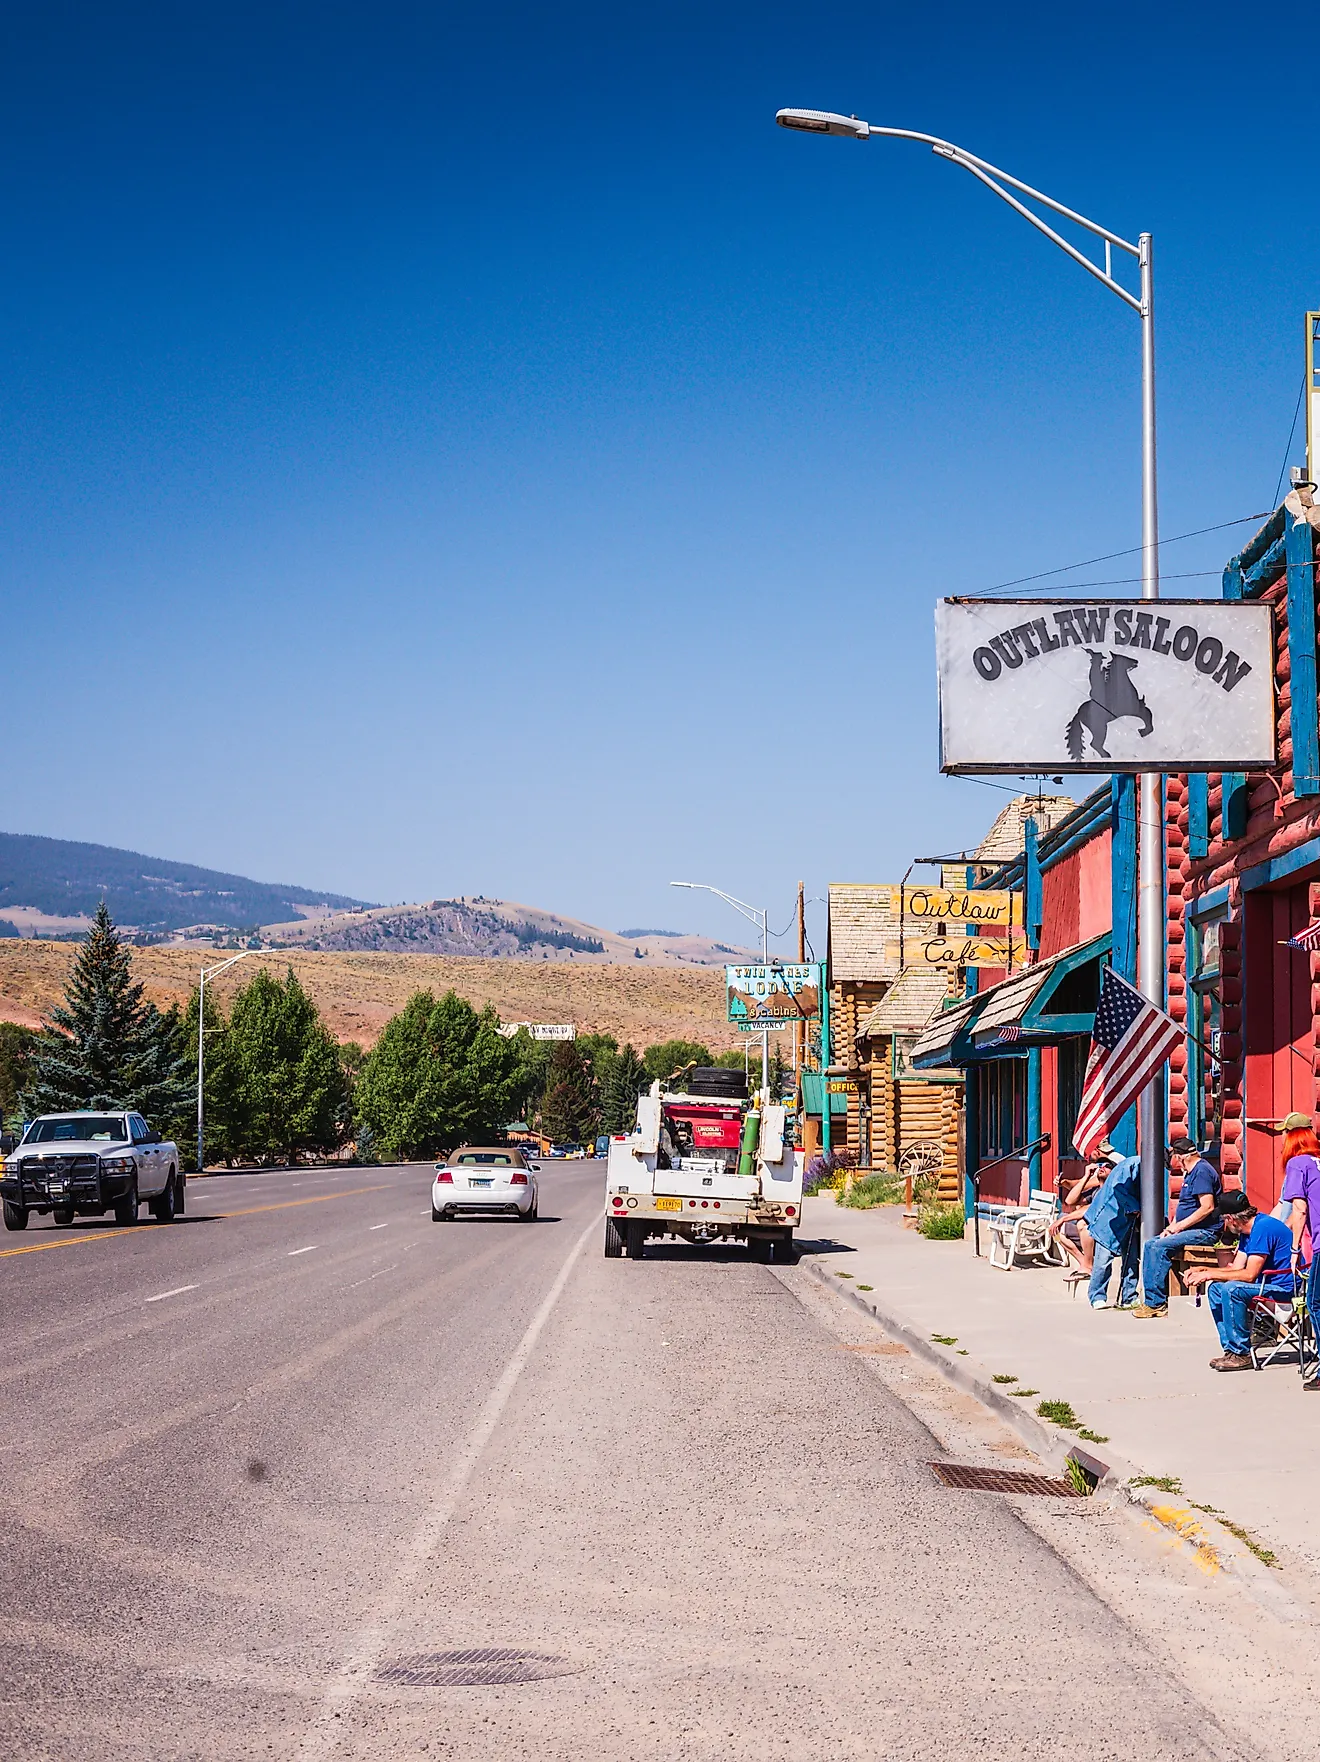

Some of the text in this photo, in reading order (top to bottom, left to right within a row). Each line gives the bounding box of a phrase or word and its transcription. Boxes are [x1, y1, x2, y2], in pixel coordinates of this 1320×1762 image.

[972, 607, 1253, 693] OUTLAW SALOON
[910, 891, 1006, 919] Outlaw
[922, 938, 980, 963] Café
[735, 967, 766, 978] TWIN
[744, 980, 803, 995] LODGE
